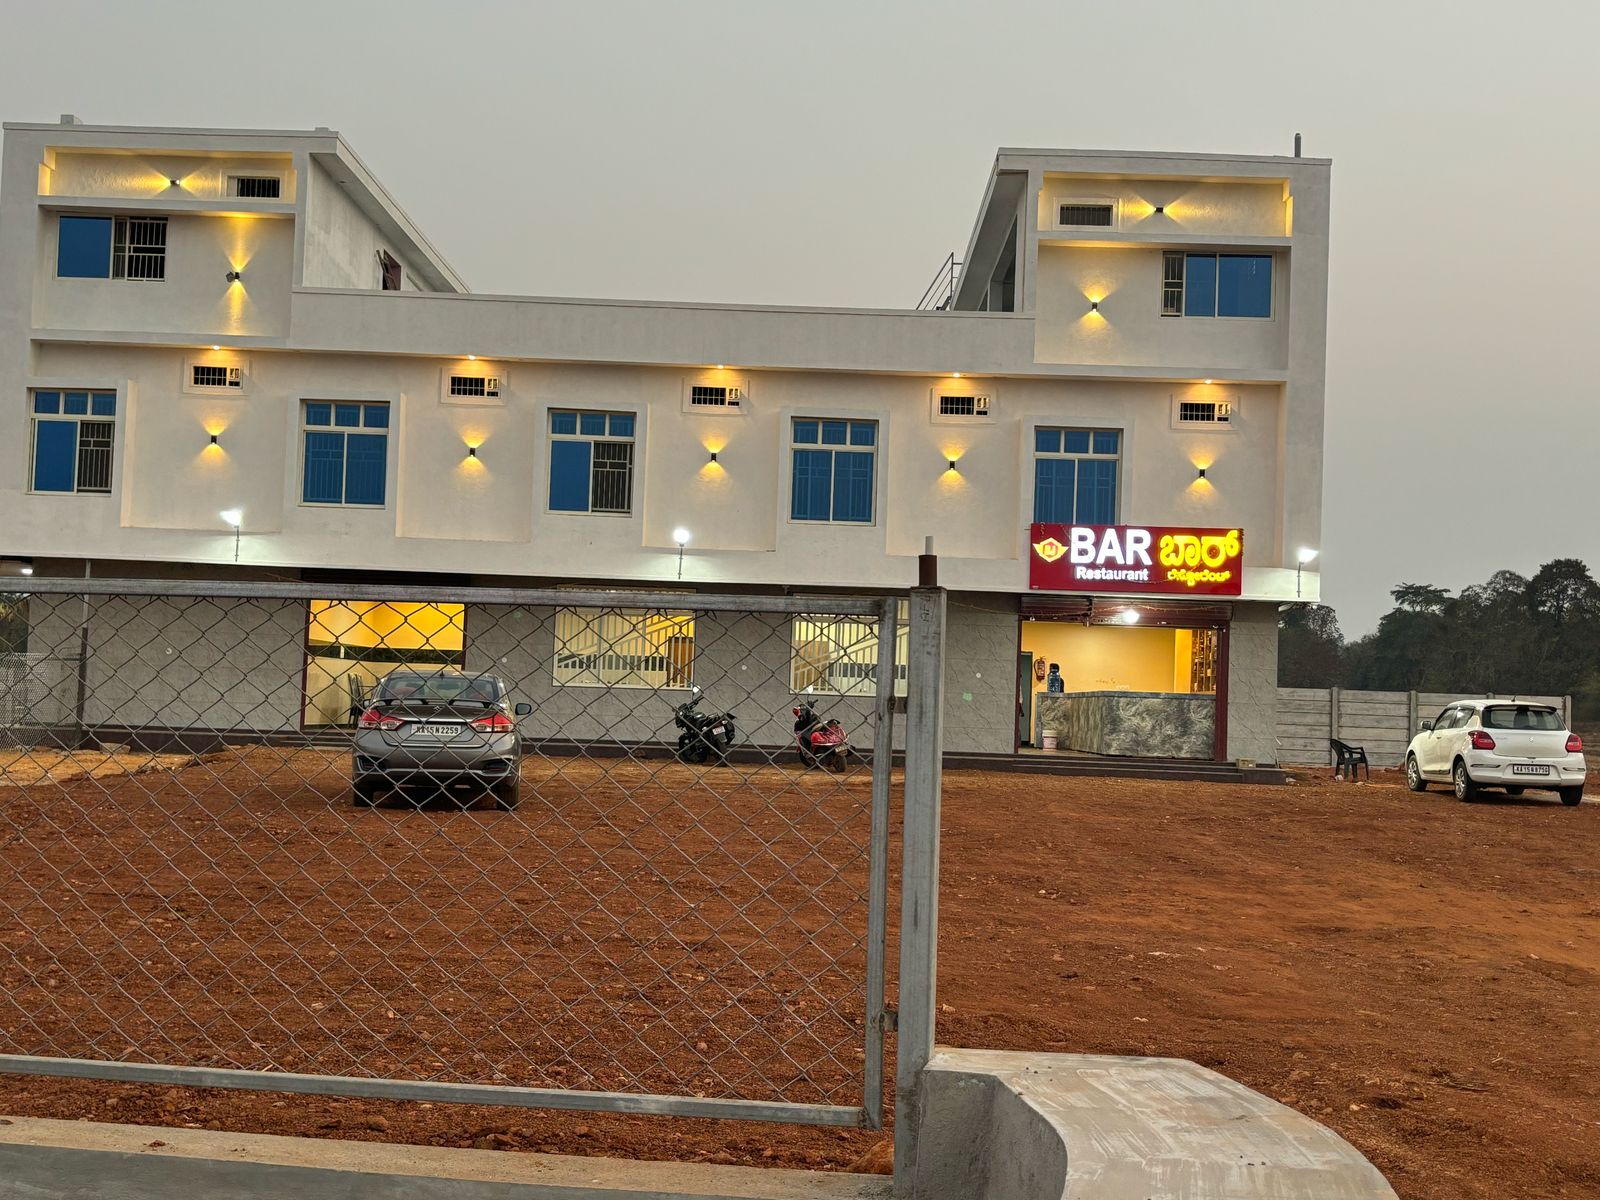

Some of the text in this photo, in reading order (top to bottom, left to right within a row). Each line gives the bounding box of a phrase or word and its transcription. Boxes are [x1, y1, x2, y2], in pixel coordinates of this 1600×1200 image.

[1070, 527, 1153, 565] BAR
[1159, 529, 1240, 568] ಬಾರ್
[1076, 566, 1149, 581] Restaurant
